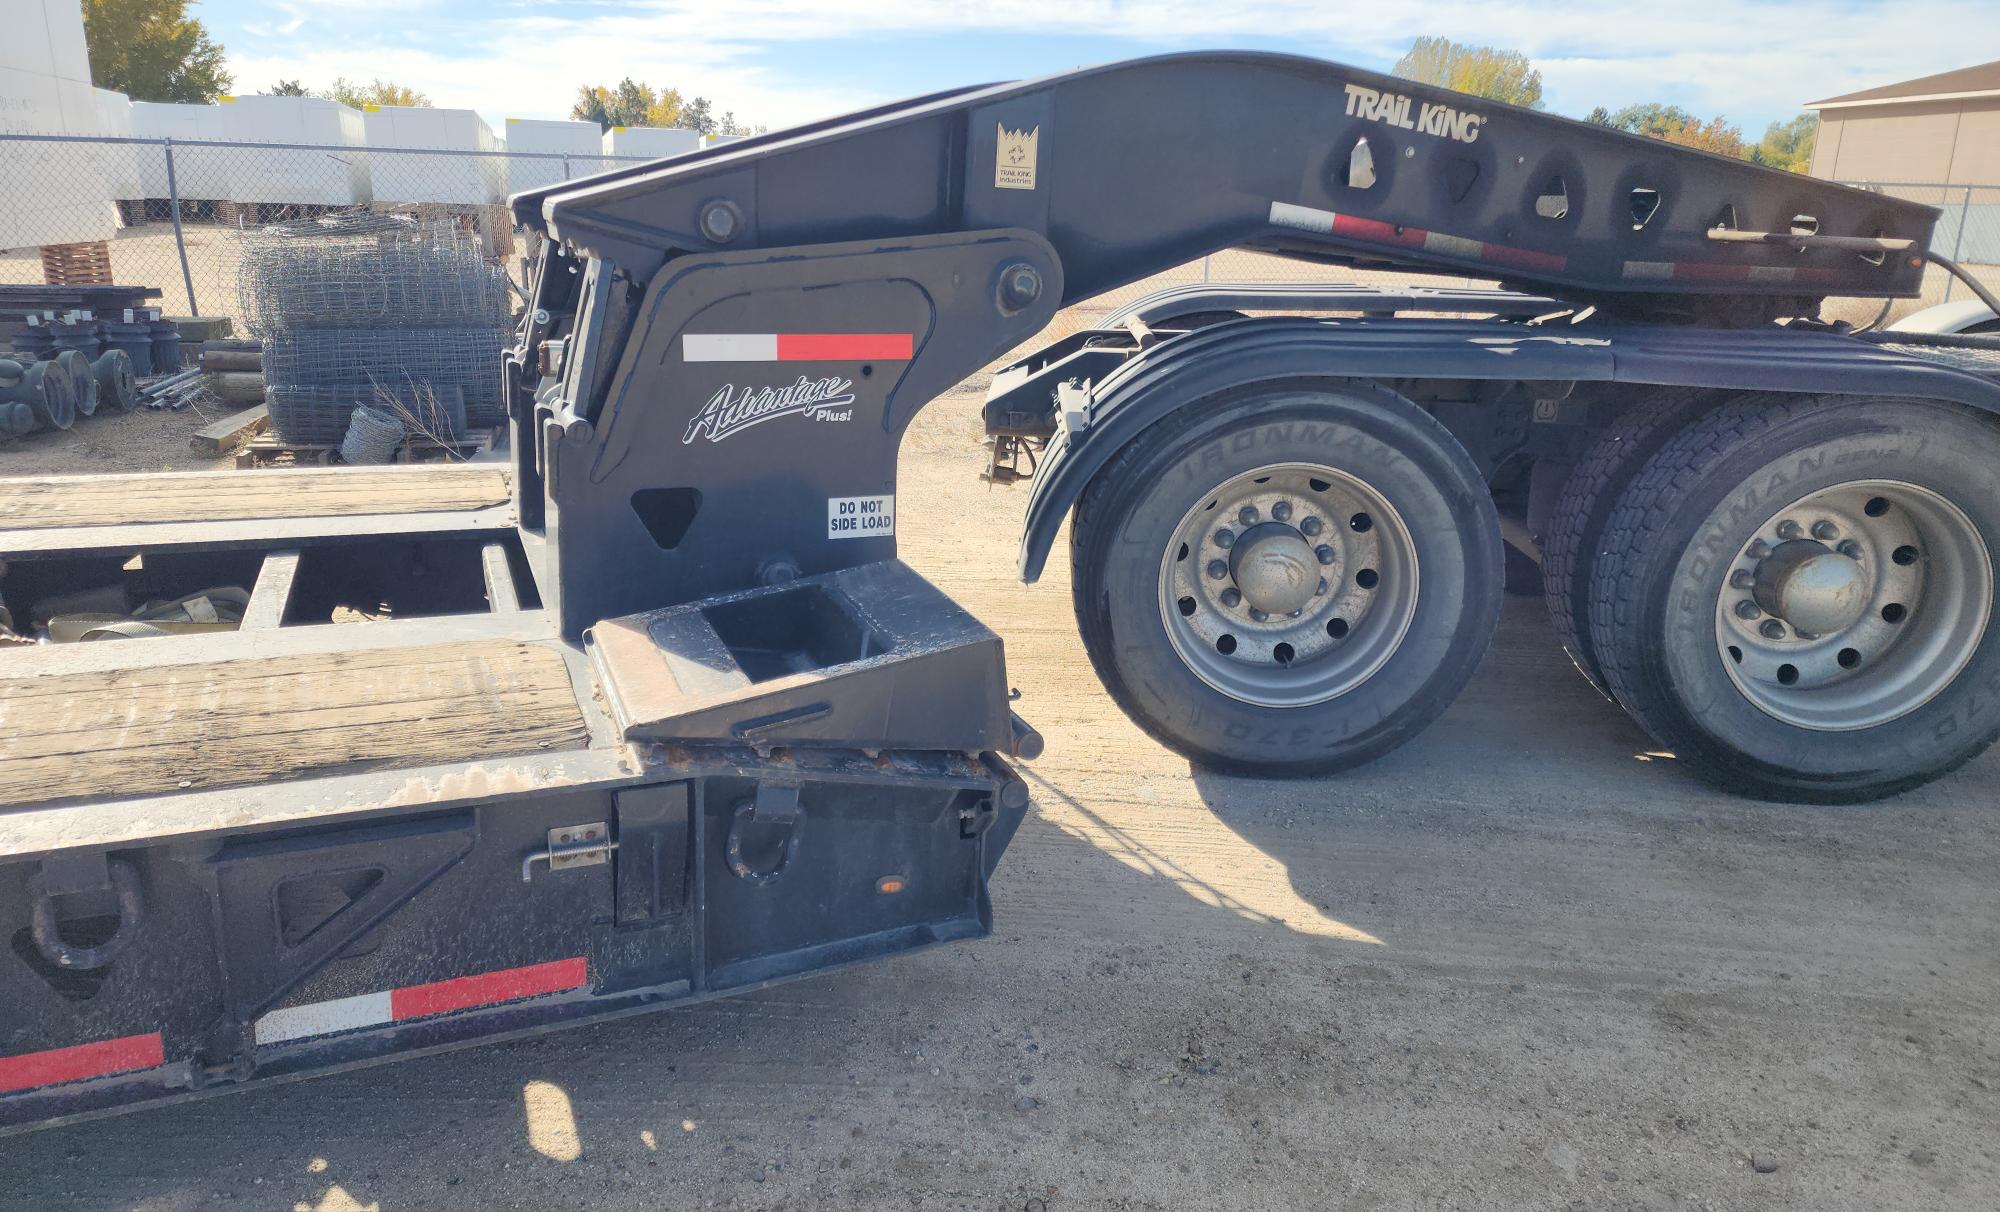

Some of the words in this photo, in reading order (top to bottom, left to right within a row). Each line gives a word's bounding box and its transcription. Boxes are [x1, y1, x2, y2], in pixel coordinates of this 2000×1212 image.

[682, 375, 855, 444] Advantage
[815, 409, 853, 422] Plus!
[839, 501, 856, 514] DO
[860, 500, 883, 513] NOT
[831, 517, 857, 531] SIDE
[862, 515, 891, 529] LOAD
